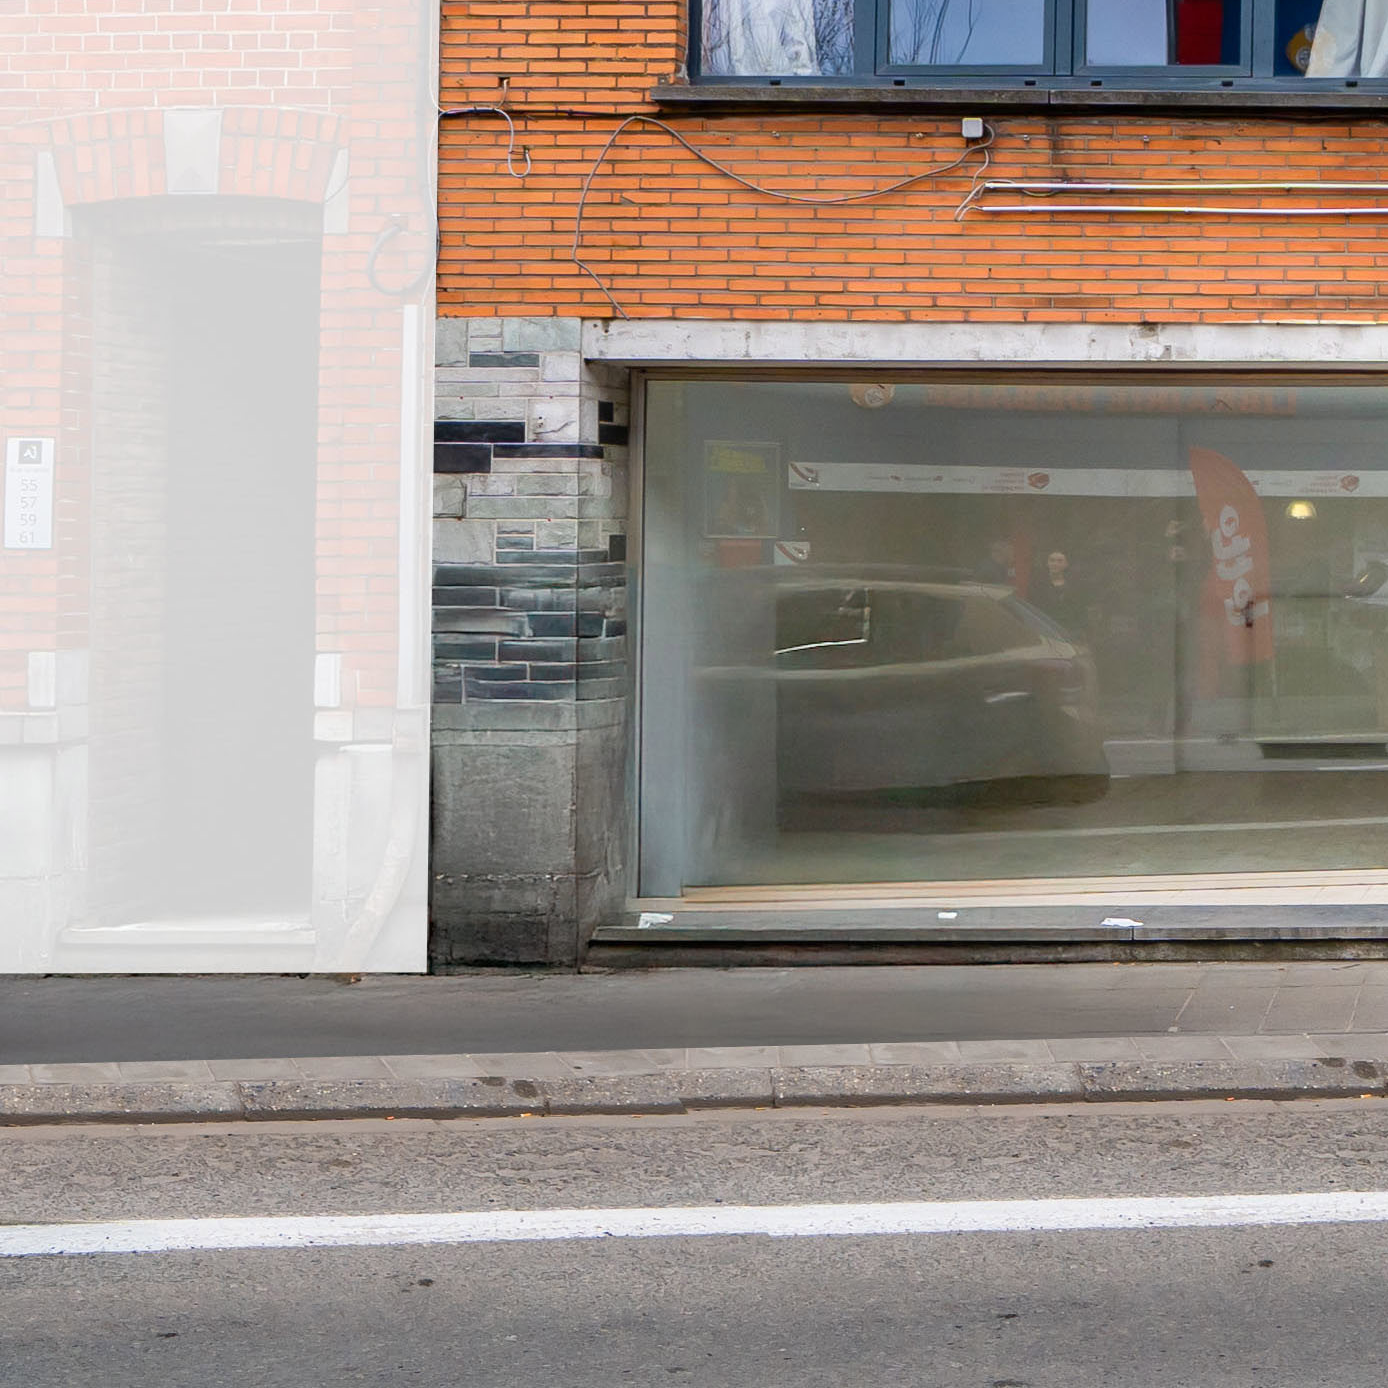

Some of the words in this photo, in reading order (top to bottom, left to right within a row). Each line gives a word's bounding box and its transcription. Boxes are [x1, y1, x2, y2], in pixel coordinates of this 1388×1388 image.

[21, 478, 38, 492] 55
[20, 496, 37, 510] 57
[20, 513, 37, 527] 59
[19, 531, 35, 544] 61
